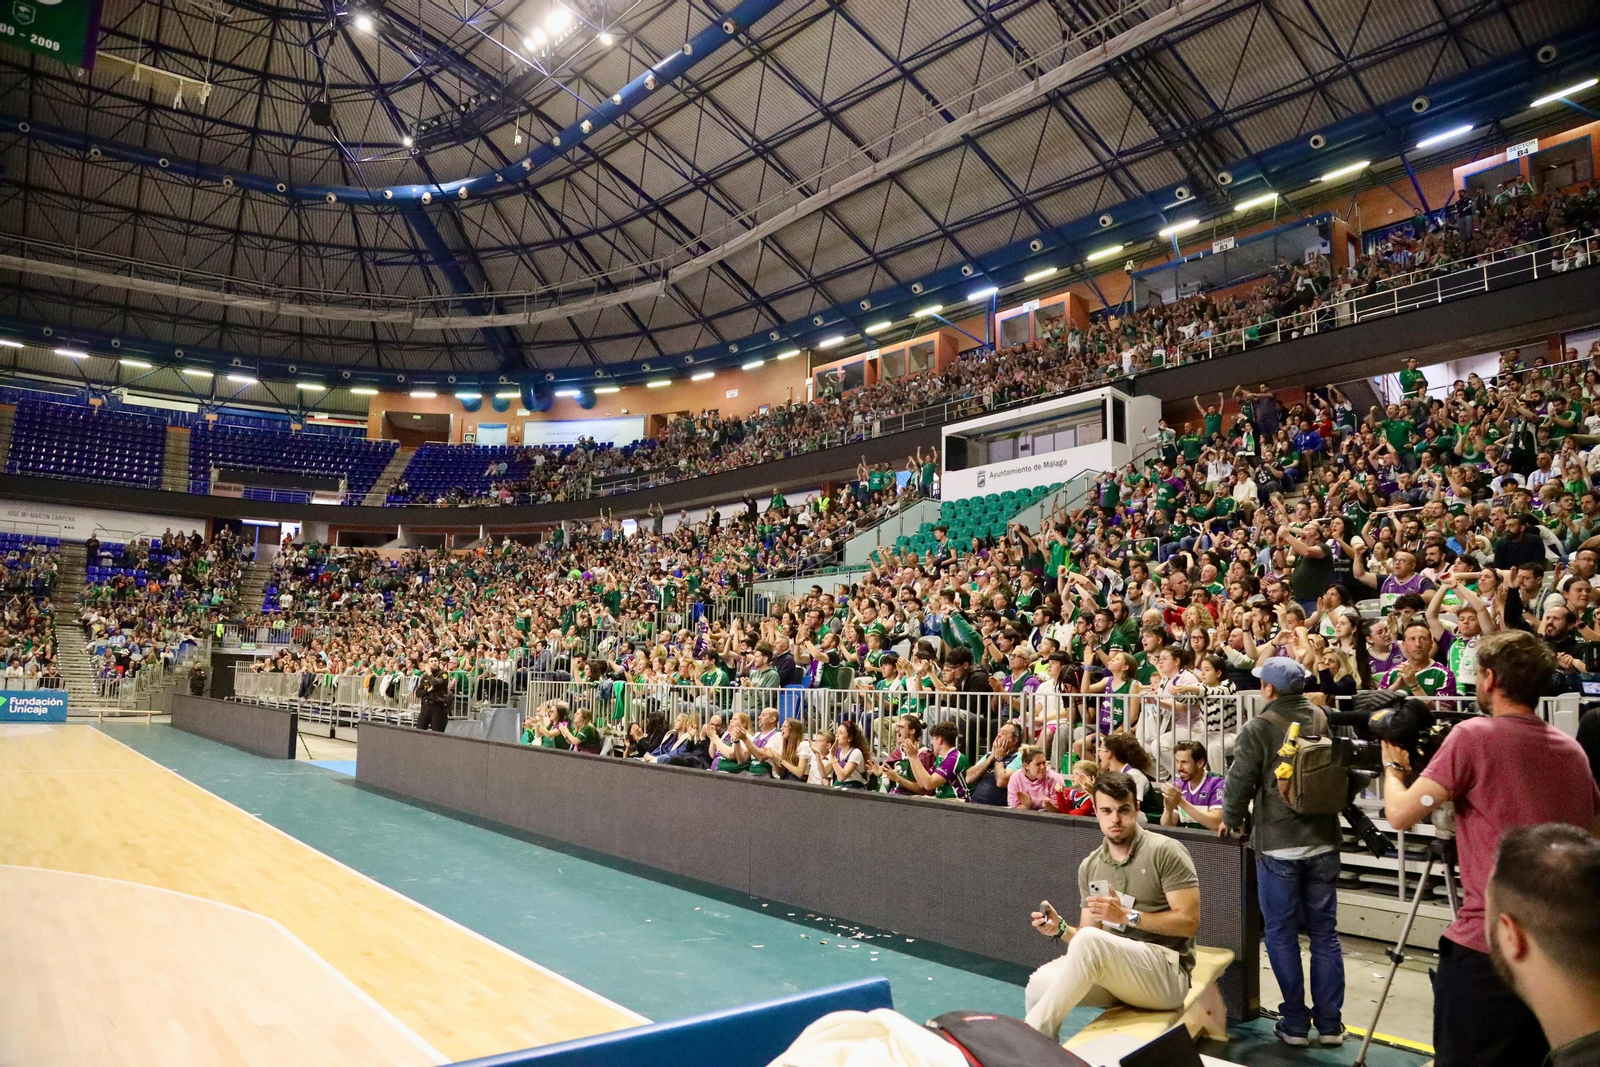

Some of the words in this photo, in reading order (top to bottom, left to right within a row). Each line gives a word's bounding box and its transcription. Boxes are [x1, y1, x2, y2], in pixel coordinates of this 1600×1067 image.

[30, 33, 60, 51] 2009
[1508, 140, 1536, 152] SECTOR
[1517, 148, 1529, 157] B4
[989, 466, 1032, 479] Ayuntamiento
[1033, 462, 1042, 471] de
[1043, 458, 1068, 469] Málaga
[51, 514, 76, 522] CARPENA
[10, 696, 64, 706] Fundación
[9, 704, 49, 716] Unicaja
